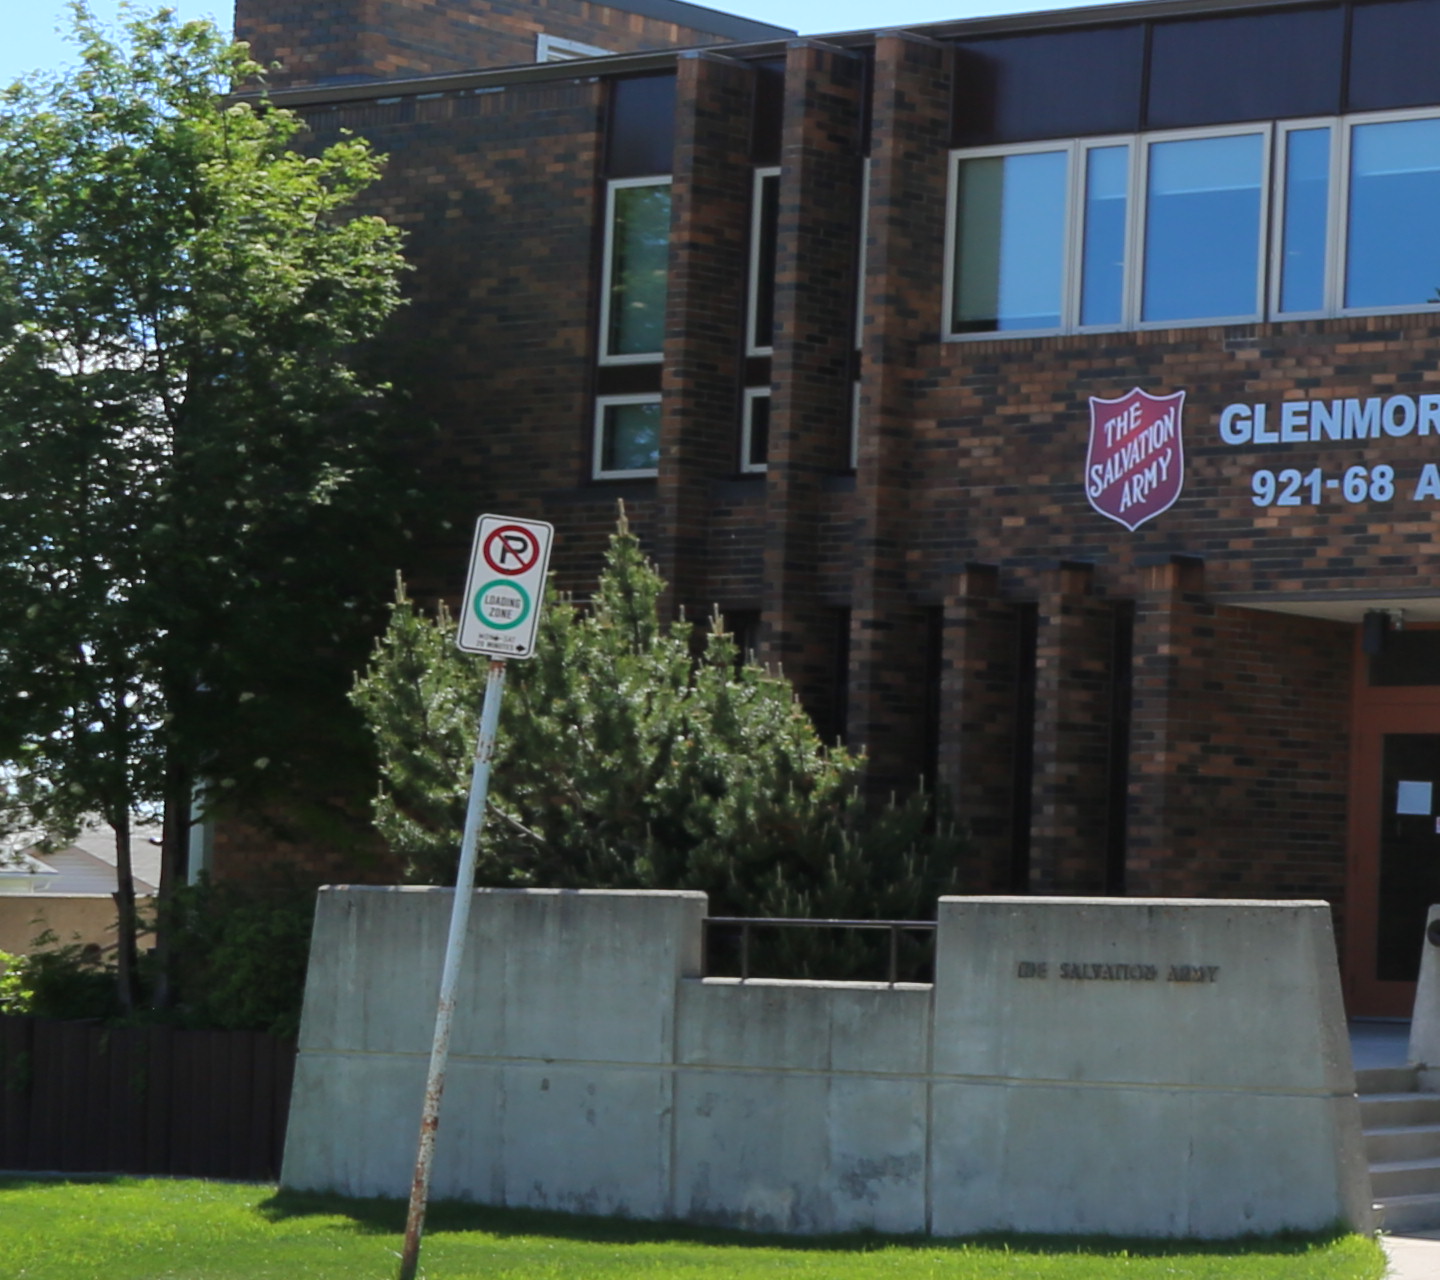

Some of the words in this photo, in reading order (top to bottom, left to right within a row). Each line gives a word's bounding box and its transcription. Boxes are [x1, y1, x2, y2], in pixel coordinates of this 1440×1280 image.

[1104, 402, 1143, 448] THE
[1090, 406, 1175, 498] SALVATION
[1120, 447, 1172, 513] ARMY
[1252, 464, 1395, 507] 921-68
[485, 595, 521, 608] LOADING
[489, 607, 513, 619] ZONE
[1060, 962, 1158, 981] SALVATION
[1166, 965, 1220, 983] ARMY
